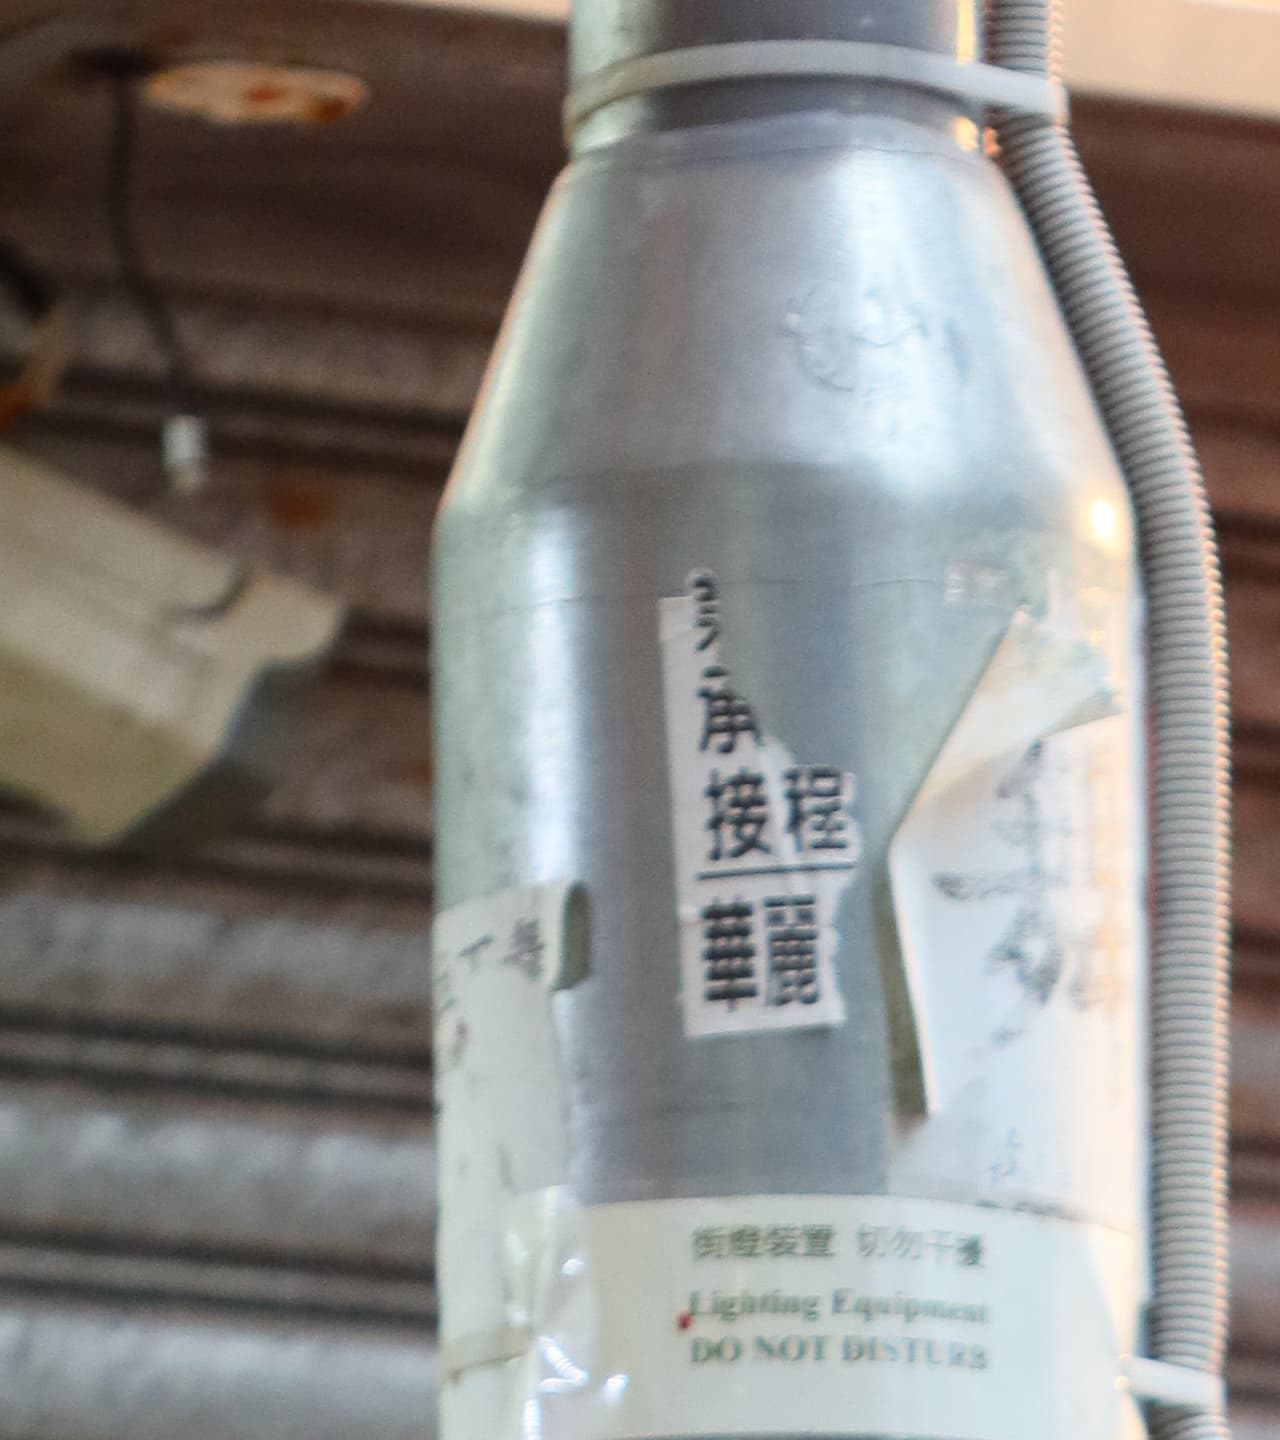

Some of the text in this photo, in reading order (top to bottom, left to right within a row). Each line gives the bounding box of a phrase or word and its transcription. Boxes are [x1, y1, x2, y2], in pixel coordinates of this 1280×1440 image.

[690, 1288, 989, 1324] Lighting Equipment
[690, 1334, 989, 1371] DO NOT DISTURB
